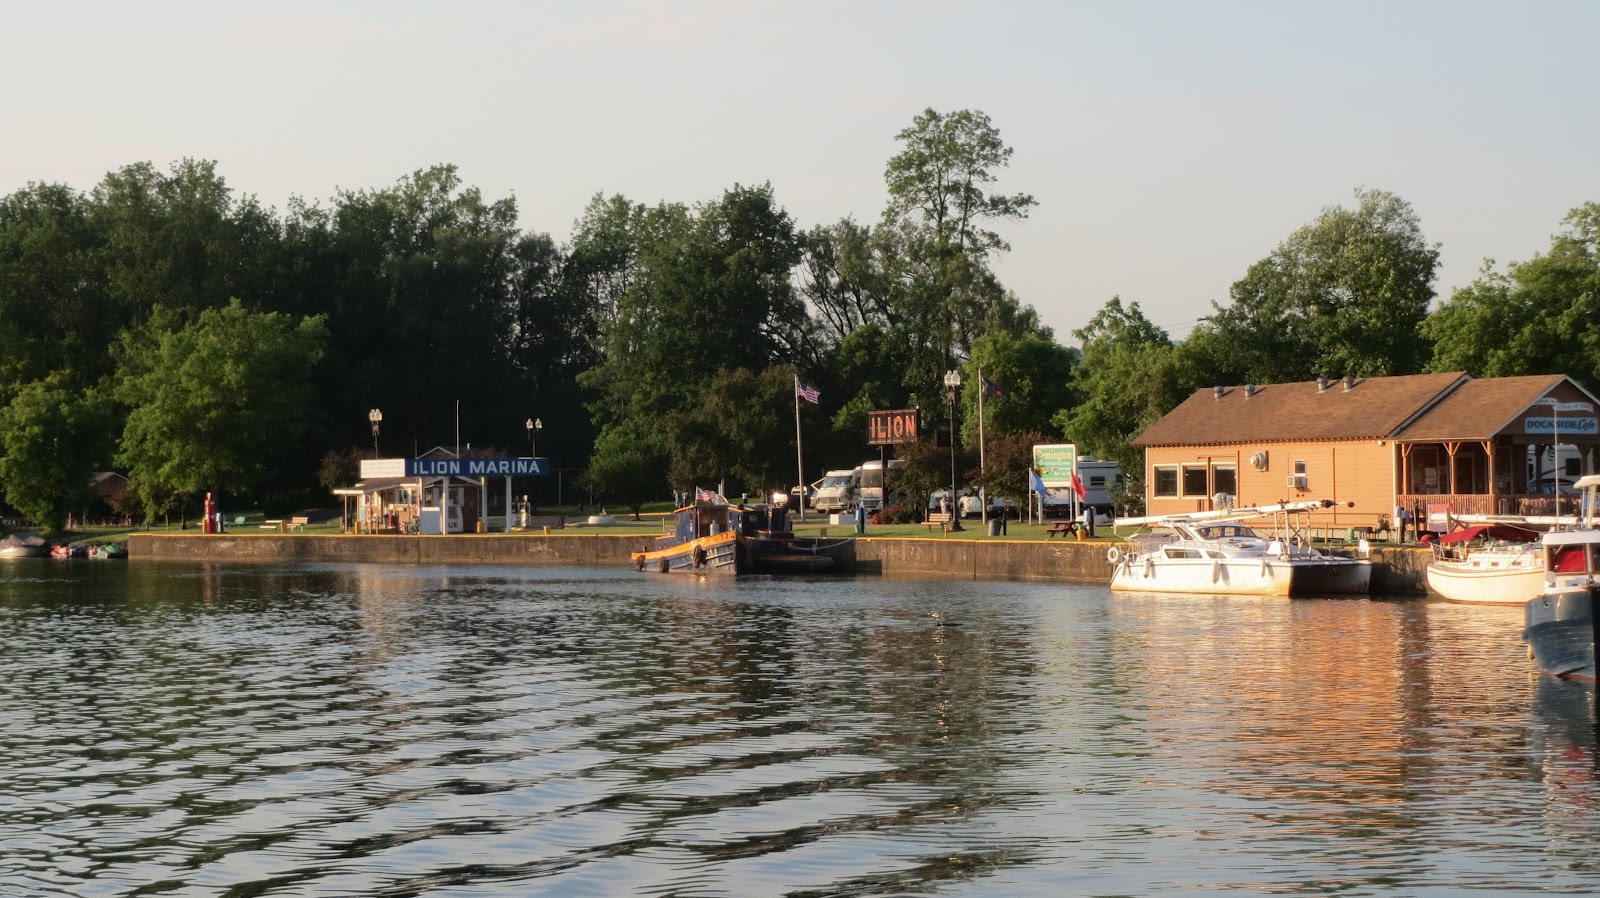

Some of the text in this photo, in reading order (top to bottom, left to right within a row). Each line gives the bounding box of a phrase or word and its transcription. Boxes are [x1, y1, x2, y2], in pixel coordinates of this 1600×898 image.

[871, 415, 915, 438] ILION
[1527, 420, 1576, 428] DOCKSIDE
[413, 461, 460, 475] ILION
[469, 460, 541, 474] MARINA
